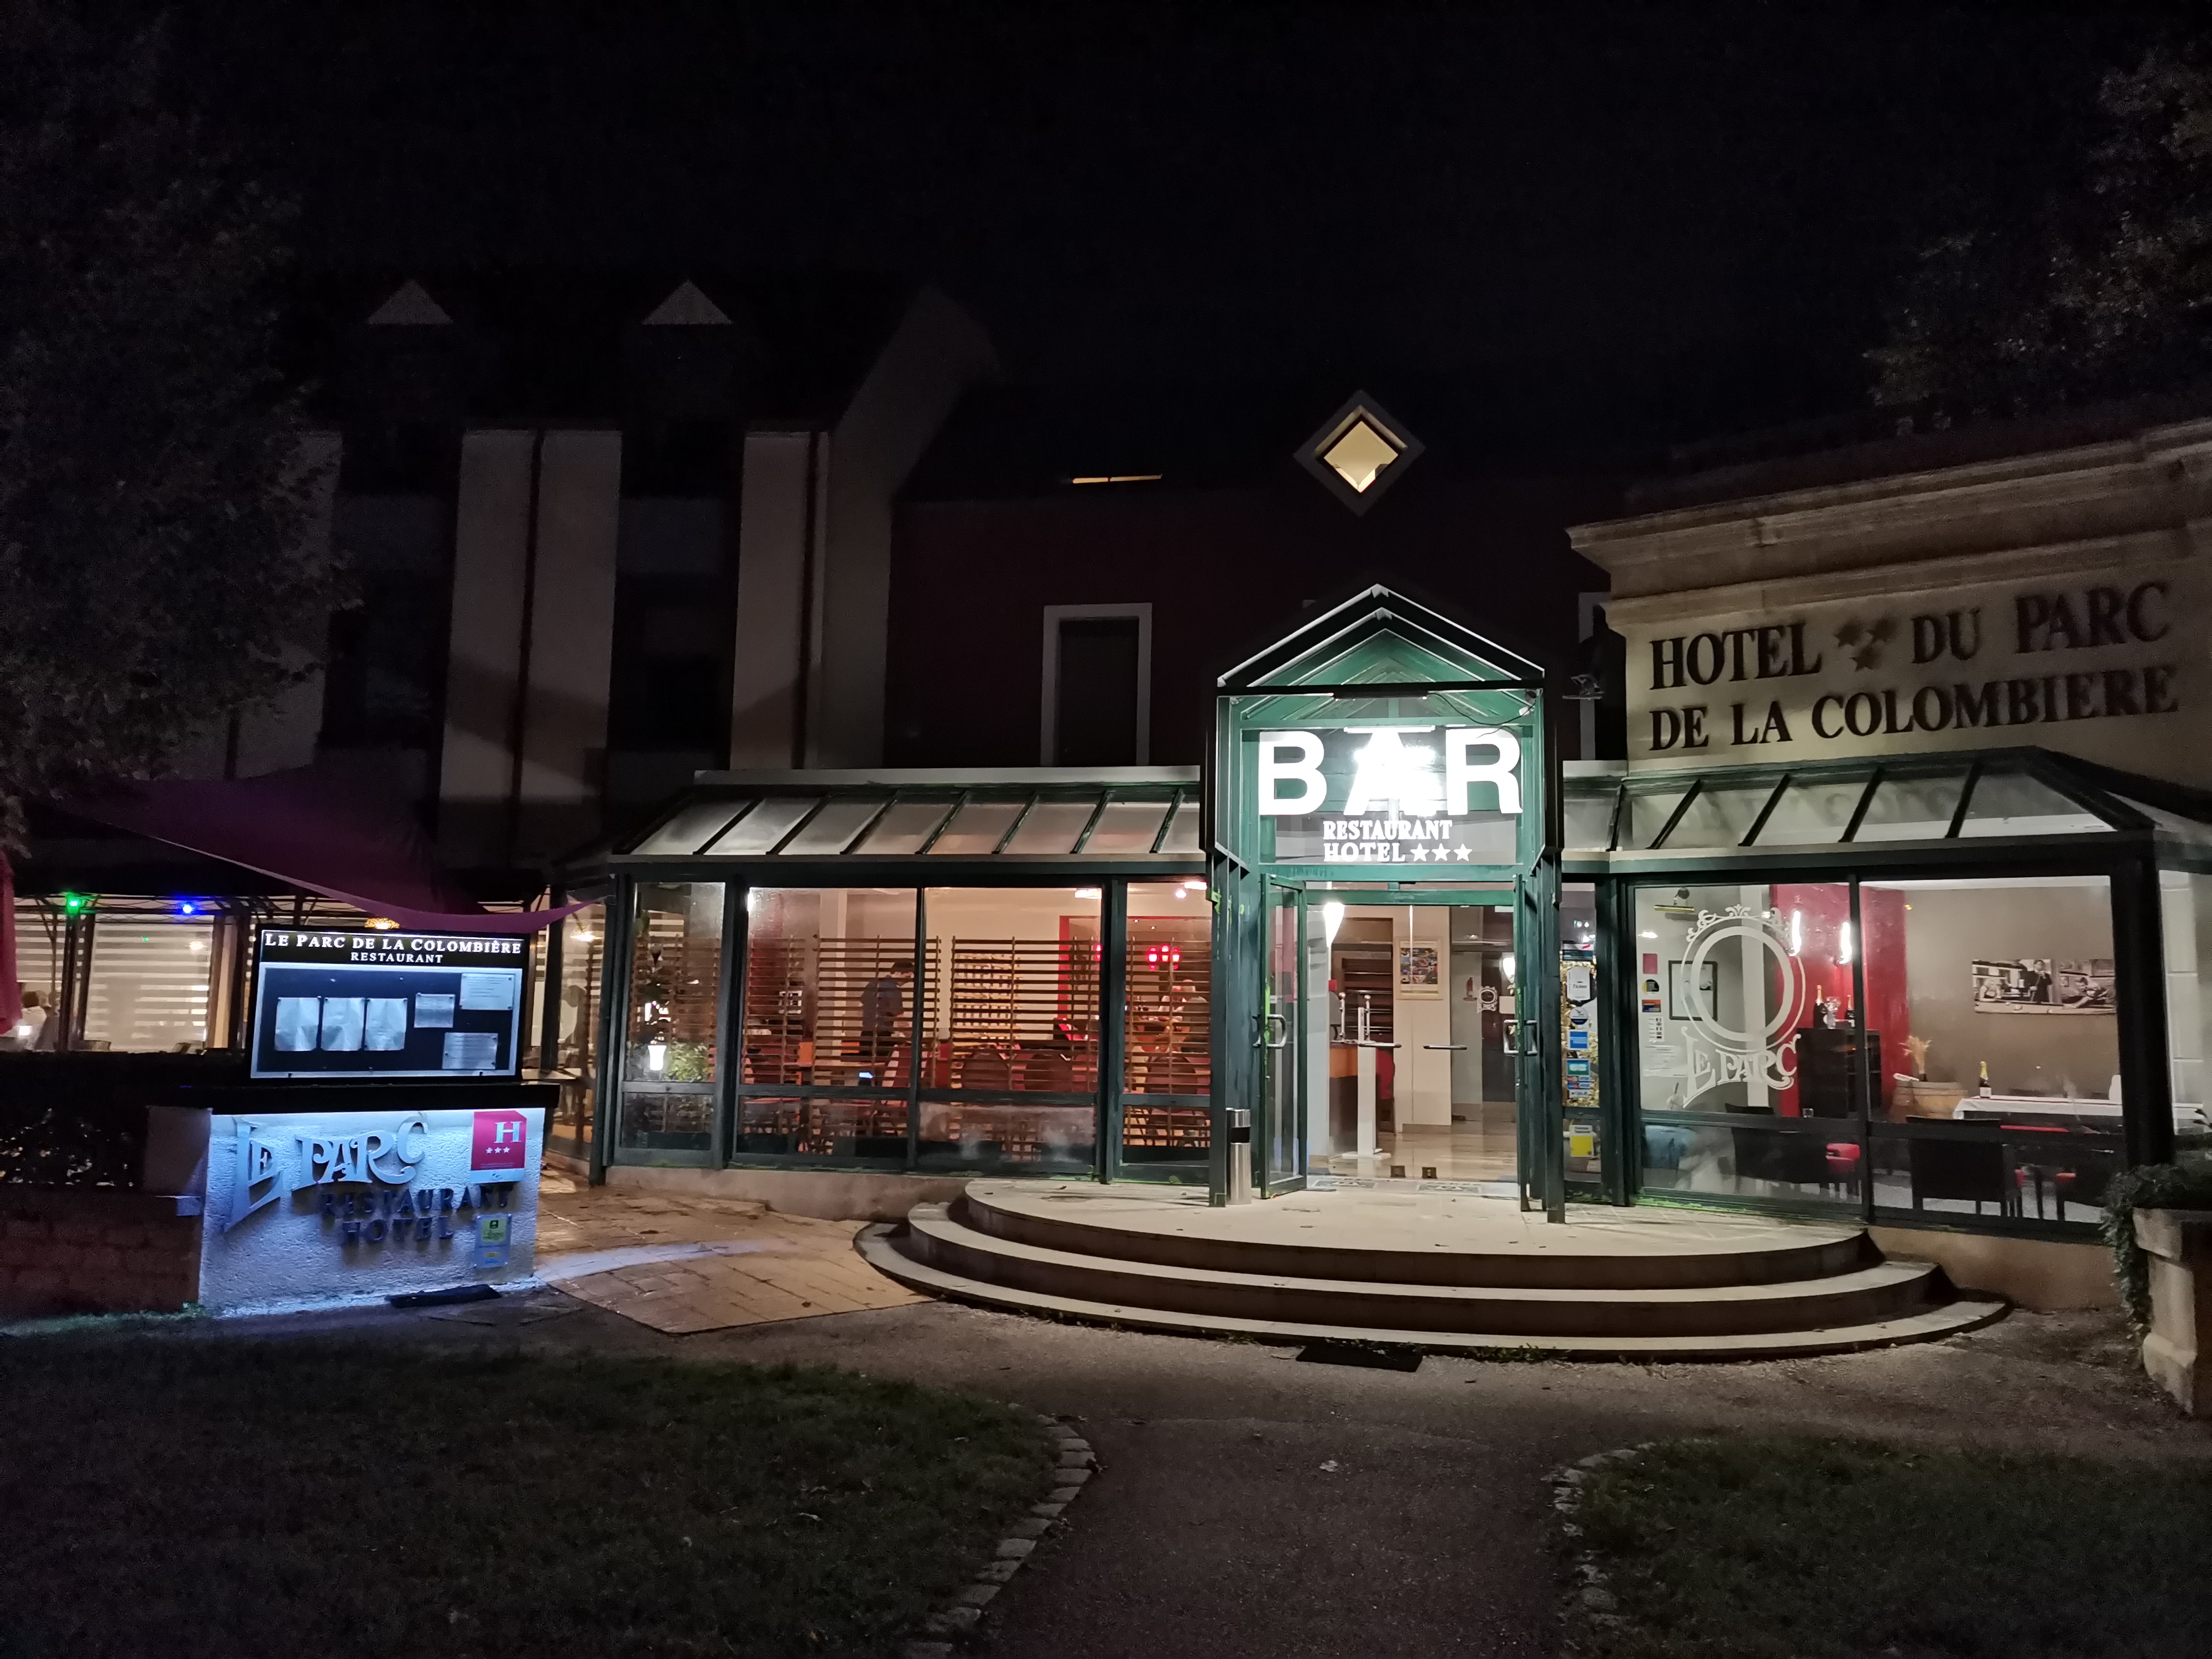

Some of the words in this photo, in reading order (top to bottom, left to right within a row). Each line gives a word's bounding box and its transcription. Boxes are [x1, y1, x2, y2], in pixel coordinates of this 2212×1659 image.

[1650, 622, 1822, 690] HOTEL
[1911, 607, 1980, 664] DU
[2015, 581, 2172, 654] PARC
[1648, 706, 1708, 751] DE
[1731, 701, 1792, 744] LA
[1811, 664, 2179, 739] COLOMBIERE
[1259, 728, 1523, 816] BAR
[1323, 820, 1452, 840] RESTAURANT
[1324, 842, 1405, 862] HOTEL
[265, 933, 289, 947] LE
[296, 934, 345, 948] PARC
[353, 937, 374, 949] DE
[382, 939, 404, 950] LA
[411, 938, 521, 953] COLOMBIÈRE
[351, 952, 443, 963] RESTAURANT
[1681, 1026, 1715, 1108] LE
[1715, 1034, 1801, 1090] PARC
[494, 1121, 523, 1143] H
[224, 1116, 283, 1232] LE
[292, 1113, 427, 1191] PARC
[321, 1187, 511, 1217] RESTAURANT
[342, 1217, 453, 1244] HOTEL
